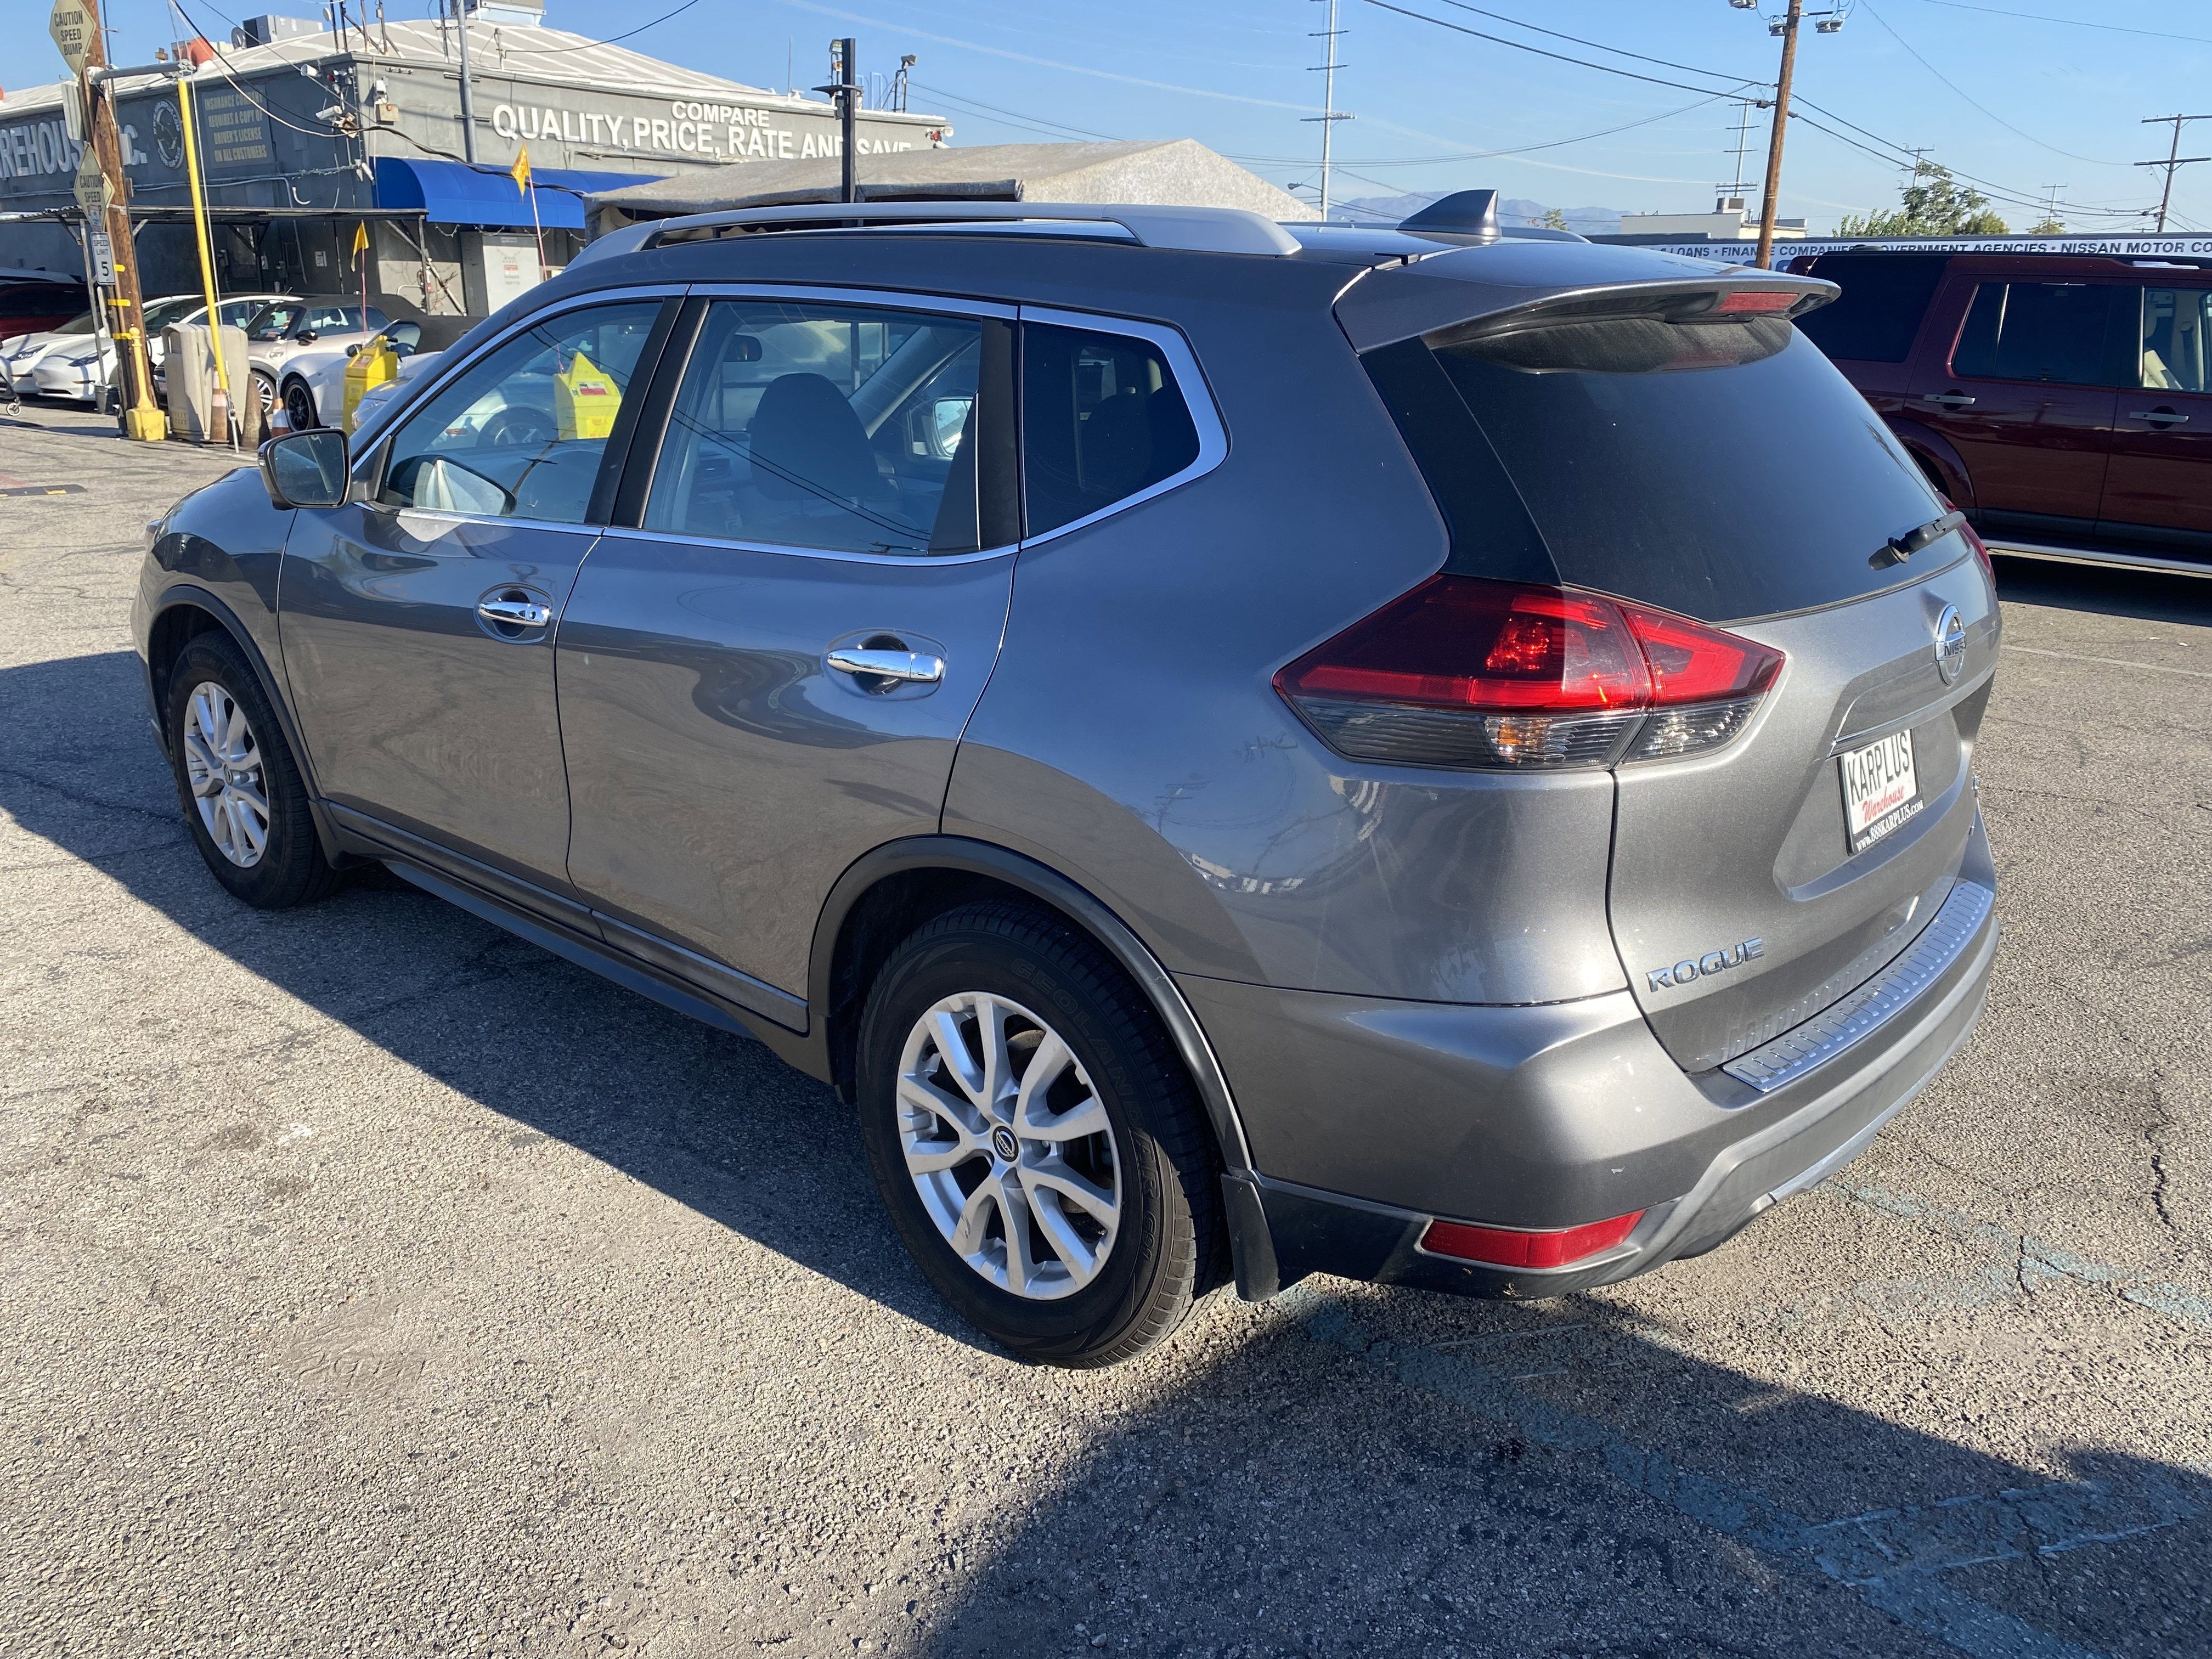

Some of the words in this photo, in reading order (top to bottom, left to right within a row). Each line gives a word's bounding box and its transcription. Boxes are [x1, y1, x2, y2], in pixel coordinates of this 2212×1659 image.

[54, 10, 83, 27] CAUTION
[60, 29, 82, 42] SPEED
[63, 43, 82, 55] BUMP
[204, 94, 235, 111] INSURANCE
[208, 112, 235, 128] REQUIRES
[234, 111, 239, 124] A
[239, 110, 255, 123] COPY
[255, 109, 263, 122] OF
[672, 101, 770, 127] COMPARE
[213, 129, 239, 145] DRIVER'S
[238, 127, 263, 142] LICENSE
[493, 104, 629, 151] QUALITY,
[633, 117, 720, 159] PRICE,
[728, 126, 793, 159] RATE
[223, 149, 233, 161] ALL
[232, 144, 268, 161] CUSTOMERS
[80, 174, 102, 188] CAUTION
[84, 191, 101, 203] SPEED
[1722, 246, 1776, 256] FINANE
[1973, 243, 2048, 252] AGENCIES
[2061, 242, 2122, 253] NISSAN
[2126, 242, 2185, 253] MOTOR
[101, 261, 109, 276] 5
[1848, 731, 1910, 806] KARPLUS
[1862, 785, 1904, 823] Warehouse
[1646, 937, 1765, 993] ROGUE
